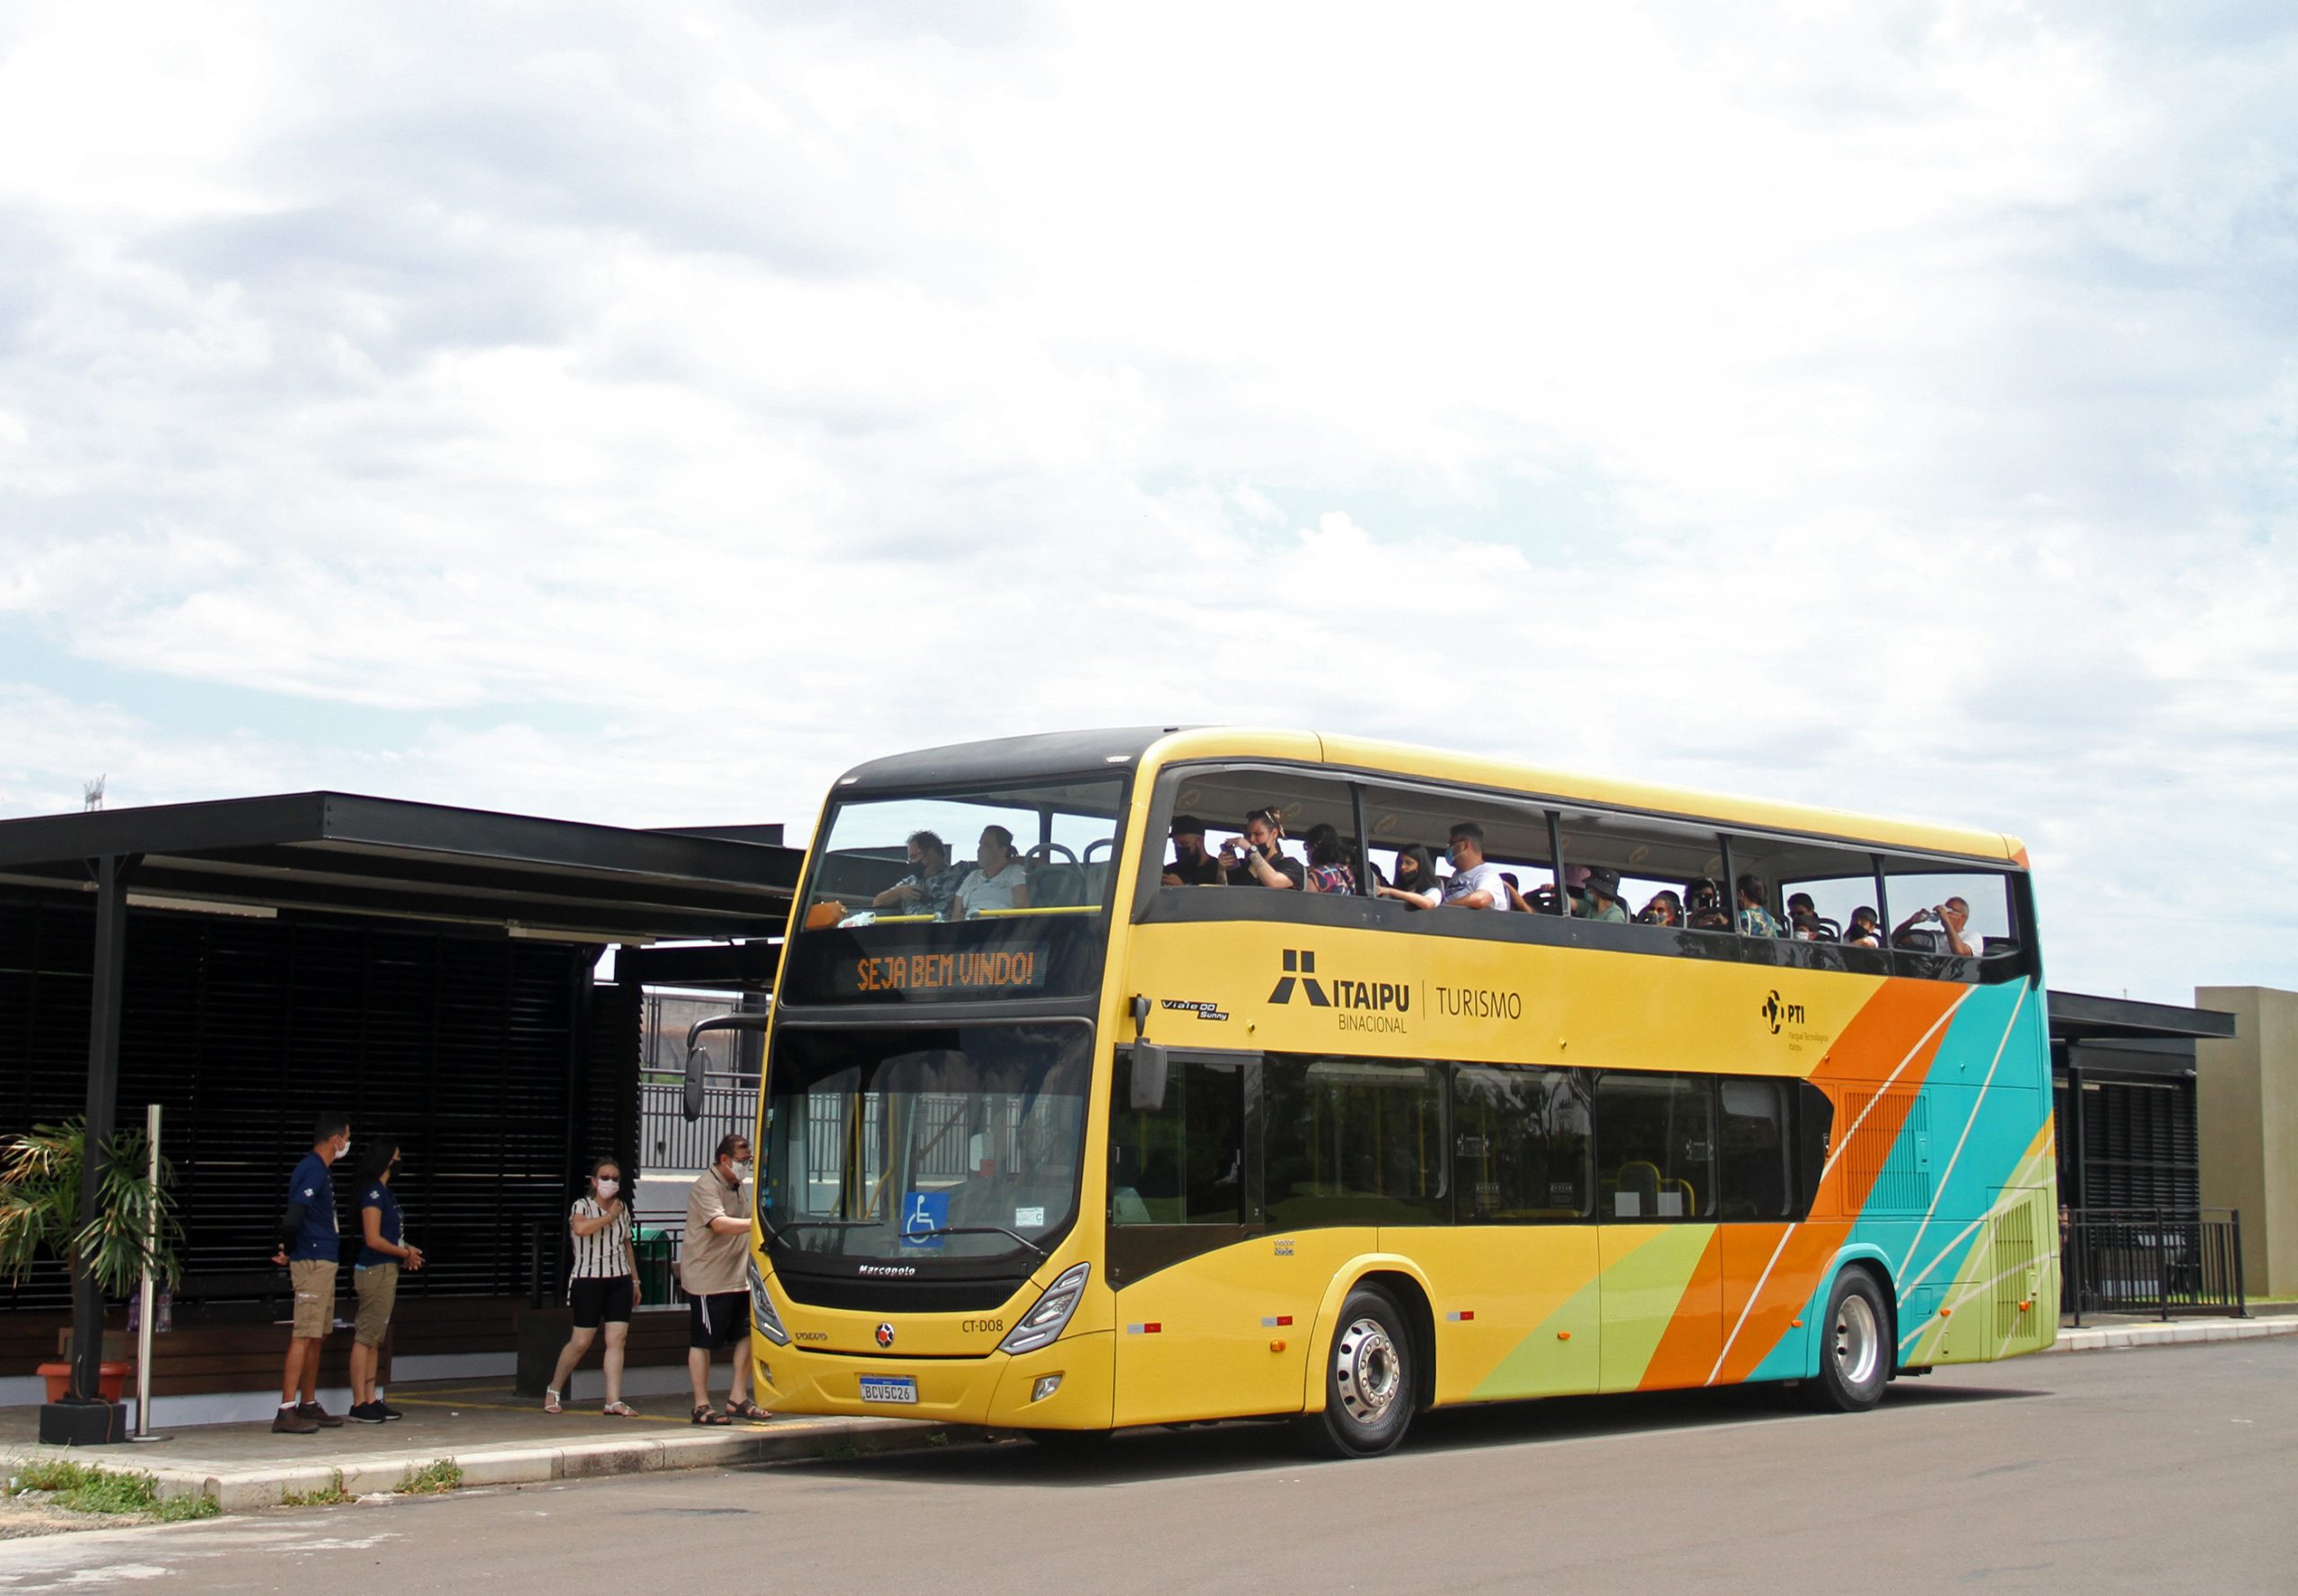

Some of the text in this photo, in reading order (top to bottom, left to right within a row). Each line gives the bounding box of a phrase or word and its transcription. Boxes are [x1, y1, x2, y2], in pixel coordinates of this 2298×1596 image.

[857, 951, 1034, 991] SEJA BEM VINDO!
[1162, 1000, 1198, 1010] Viale
[1333, 979, 1522, 1021] ITAIPU TURISMO
[1199, 1011, 1227, 1021] Sunny
[1787, 1004, 1804, 1024] PTI
[1338, 1013, 1408, 1034] BINACIONAL
[858, 1264, 916, 1276] Marcopolo
[794, 1331, 829, 1341] VOLVO
[865, 1385, 910, 1400] BCV5C26
